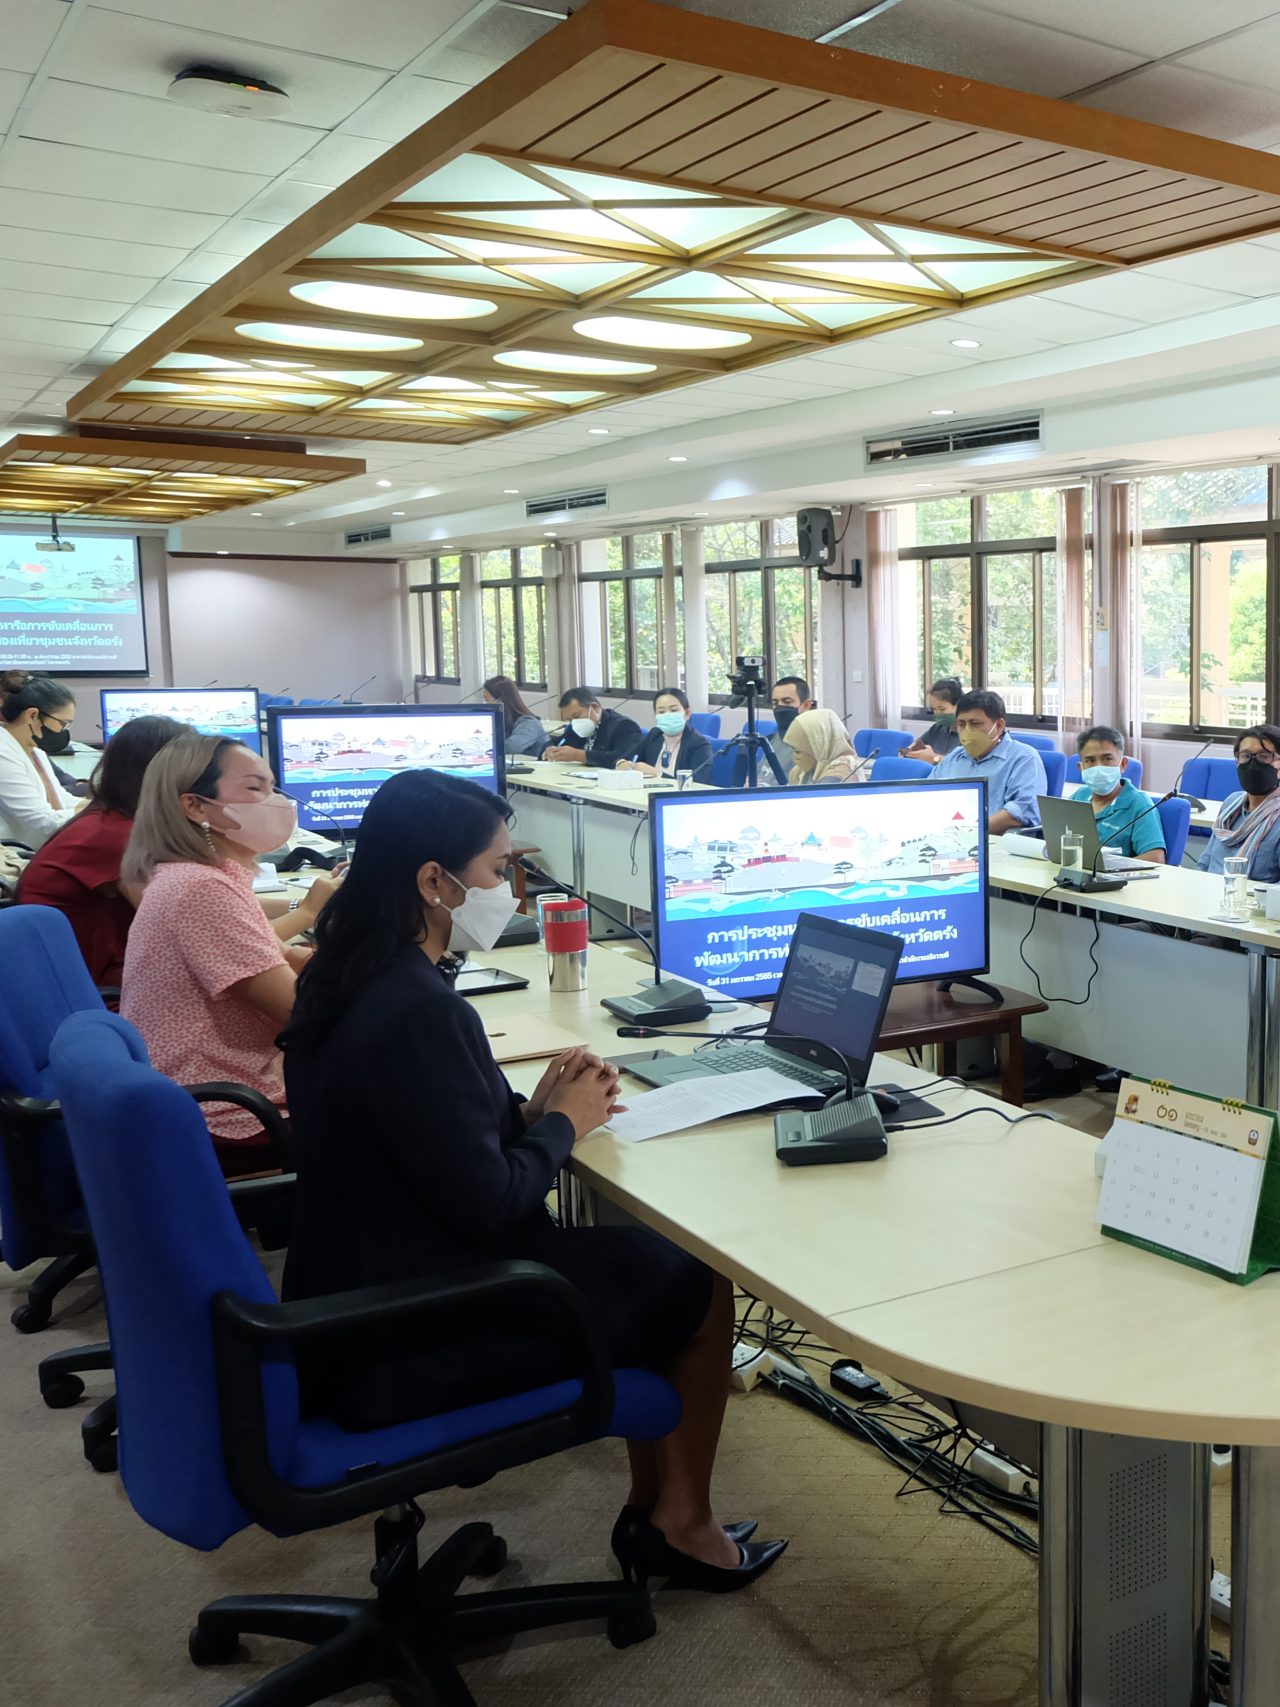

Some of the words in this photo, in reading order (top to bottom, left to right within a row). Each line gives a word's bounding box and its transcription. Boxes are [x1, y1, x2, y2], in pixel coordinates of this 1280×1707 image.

[0, 633, 123, 648] องเที่ยวชุมชนจังหวัดตรัง
[721, 977, 729, 985] 31
